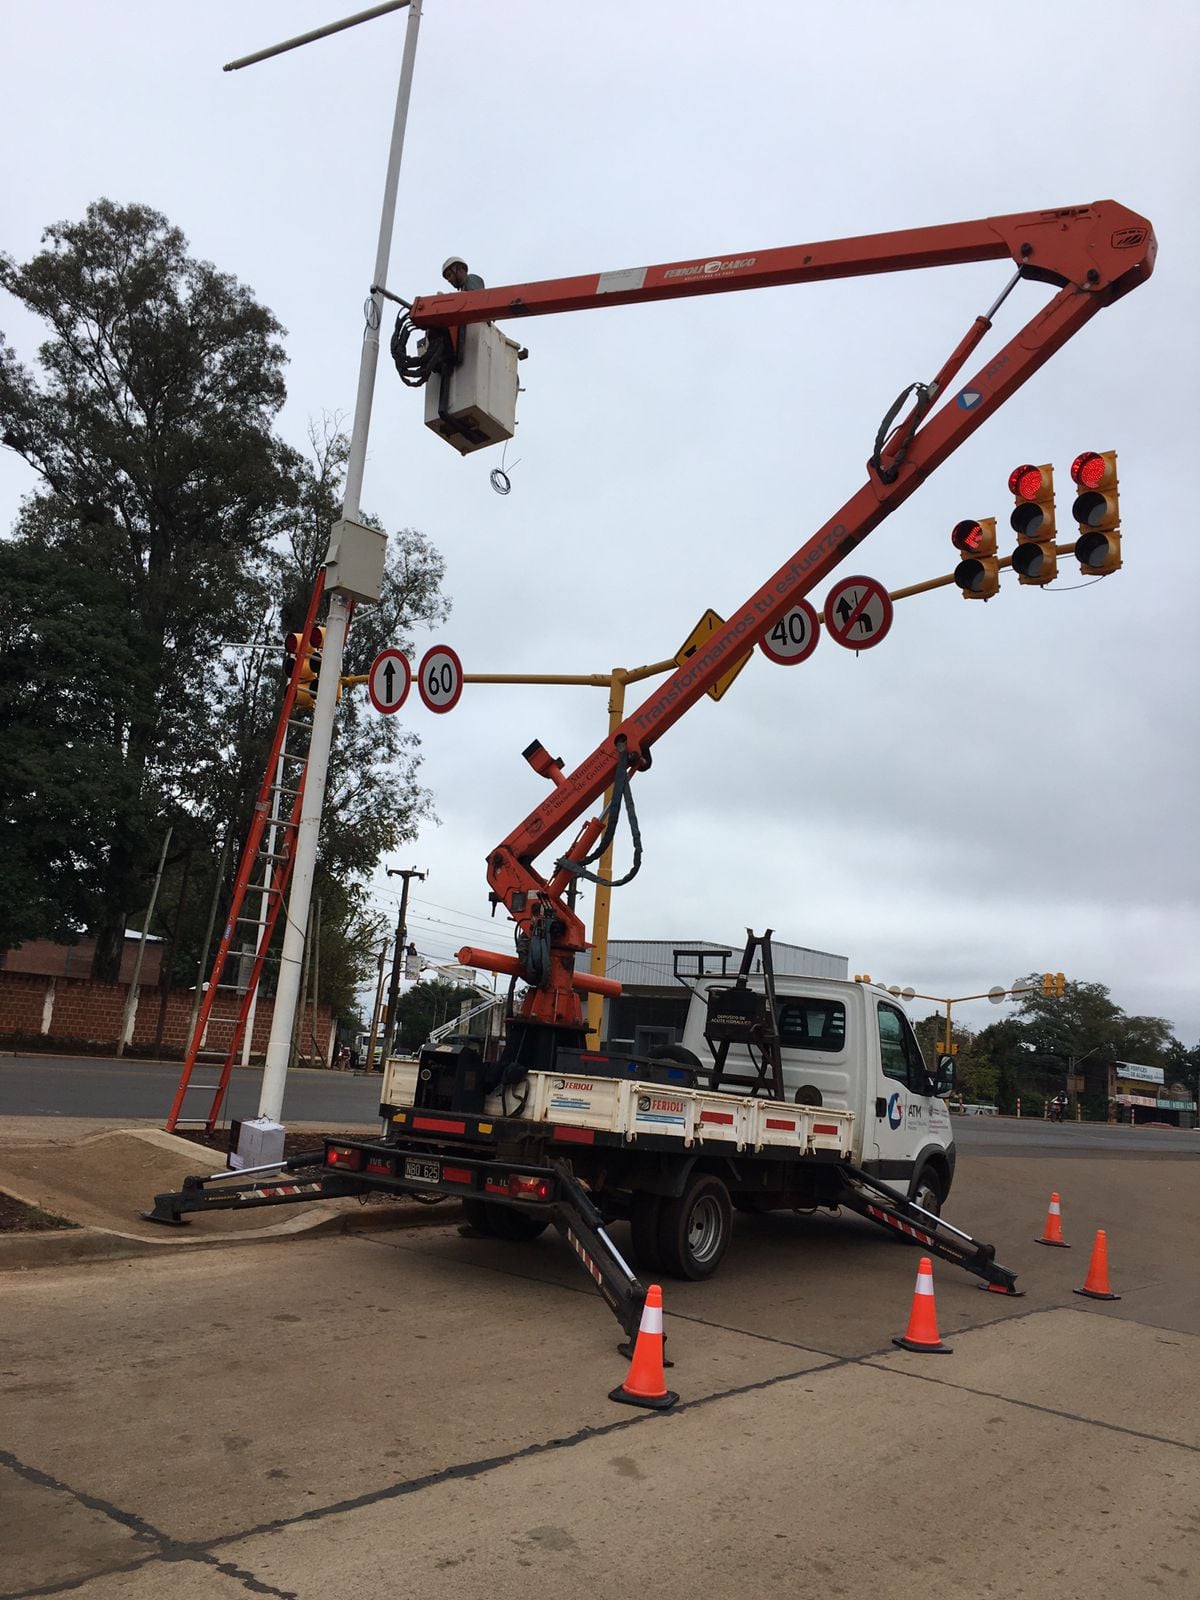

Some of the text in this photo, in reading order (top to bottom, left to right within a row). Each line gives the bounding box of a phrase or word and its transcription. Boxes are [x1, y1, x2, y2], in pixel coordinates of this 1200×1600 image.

[635, 523, 848, 730] Transformamos tu esfuerzo
[771, 612, 806, 646] 40
[428, 663, 453, 696] 60
[565, 1081, 593, 1091] FERIOLI
[652, 1099, 684, 1113] FERIOLI
[908, 1104, 922, 1118] ATM
[423, 1165, 439, 1179] 625
